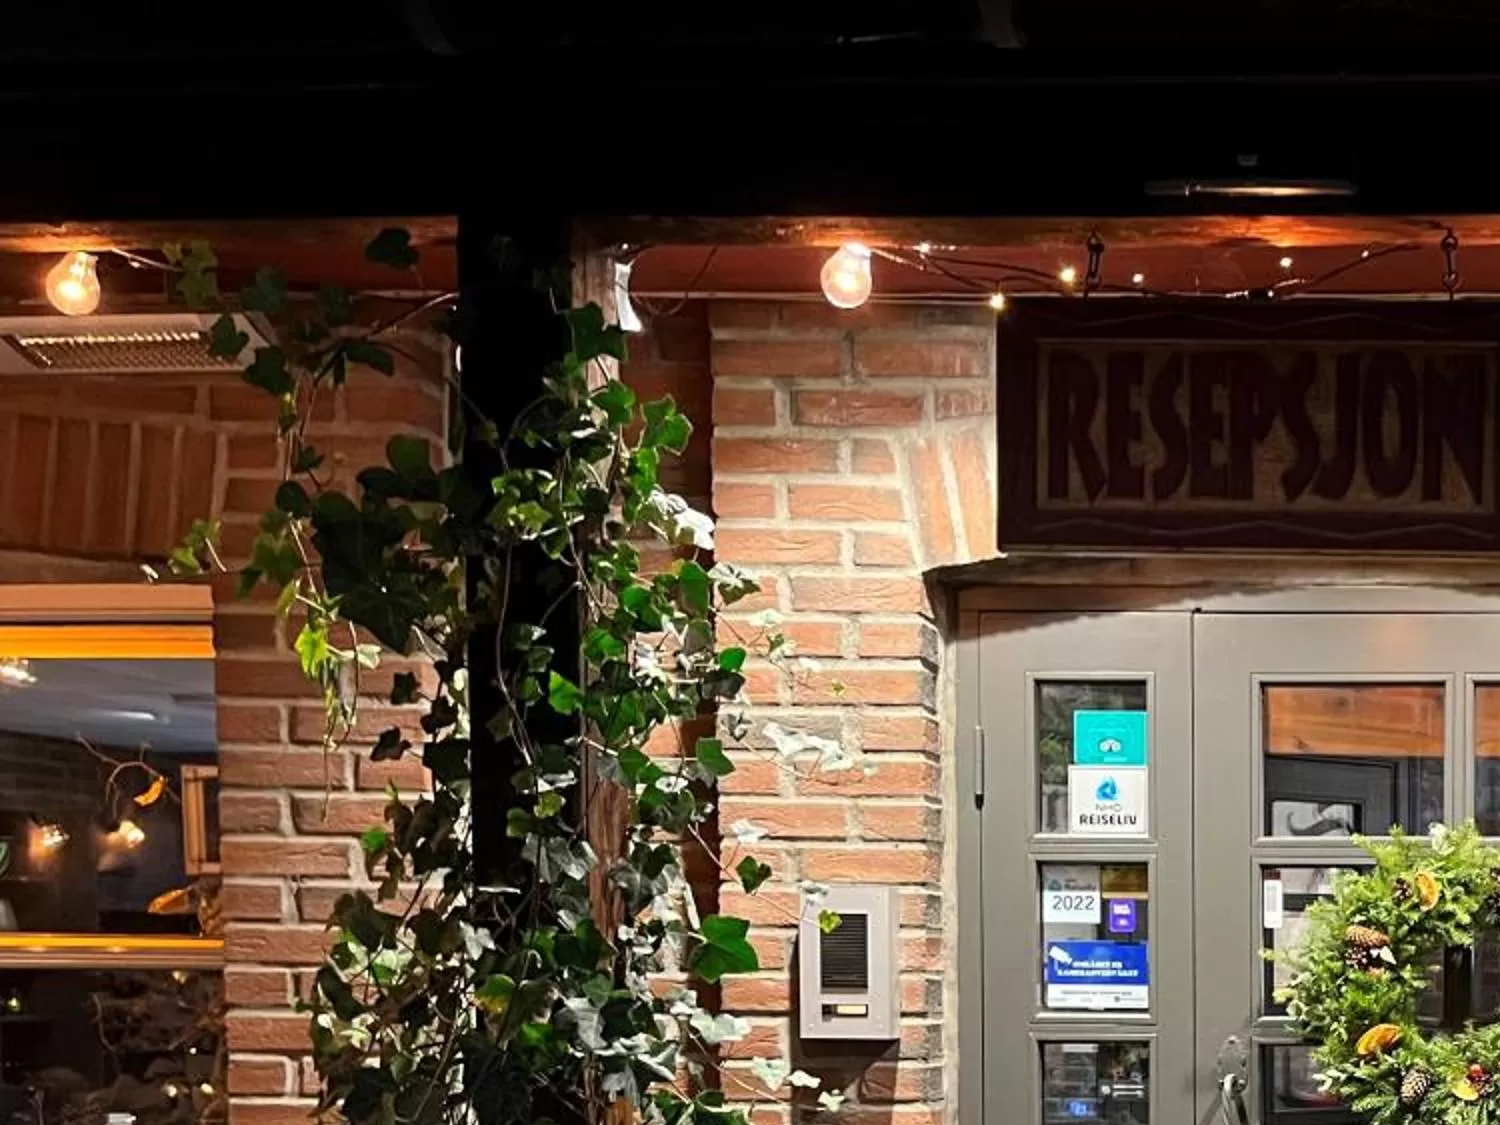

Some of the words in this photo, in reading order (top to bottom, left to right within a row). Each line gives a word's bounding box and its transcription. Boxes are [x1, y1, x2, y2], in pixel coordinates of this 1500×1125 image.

[1047, 350, 1486, 504] RESEPSJON
[1079, 814, 1137, 825] REISELIV
[1052, 895, 1095, 911] 2022
